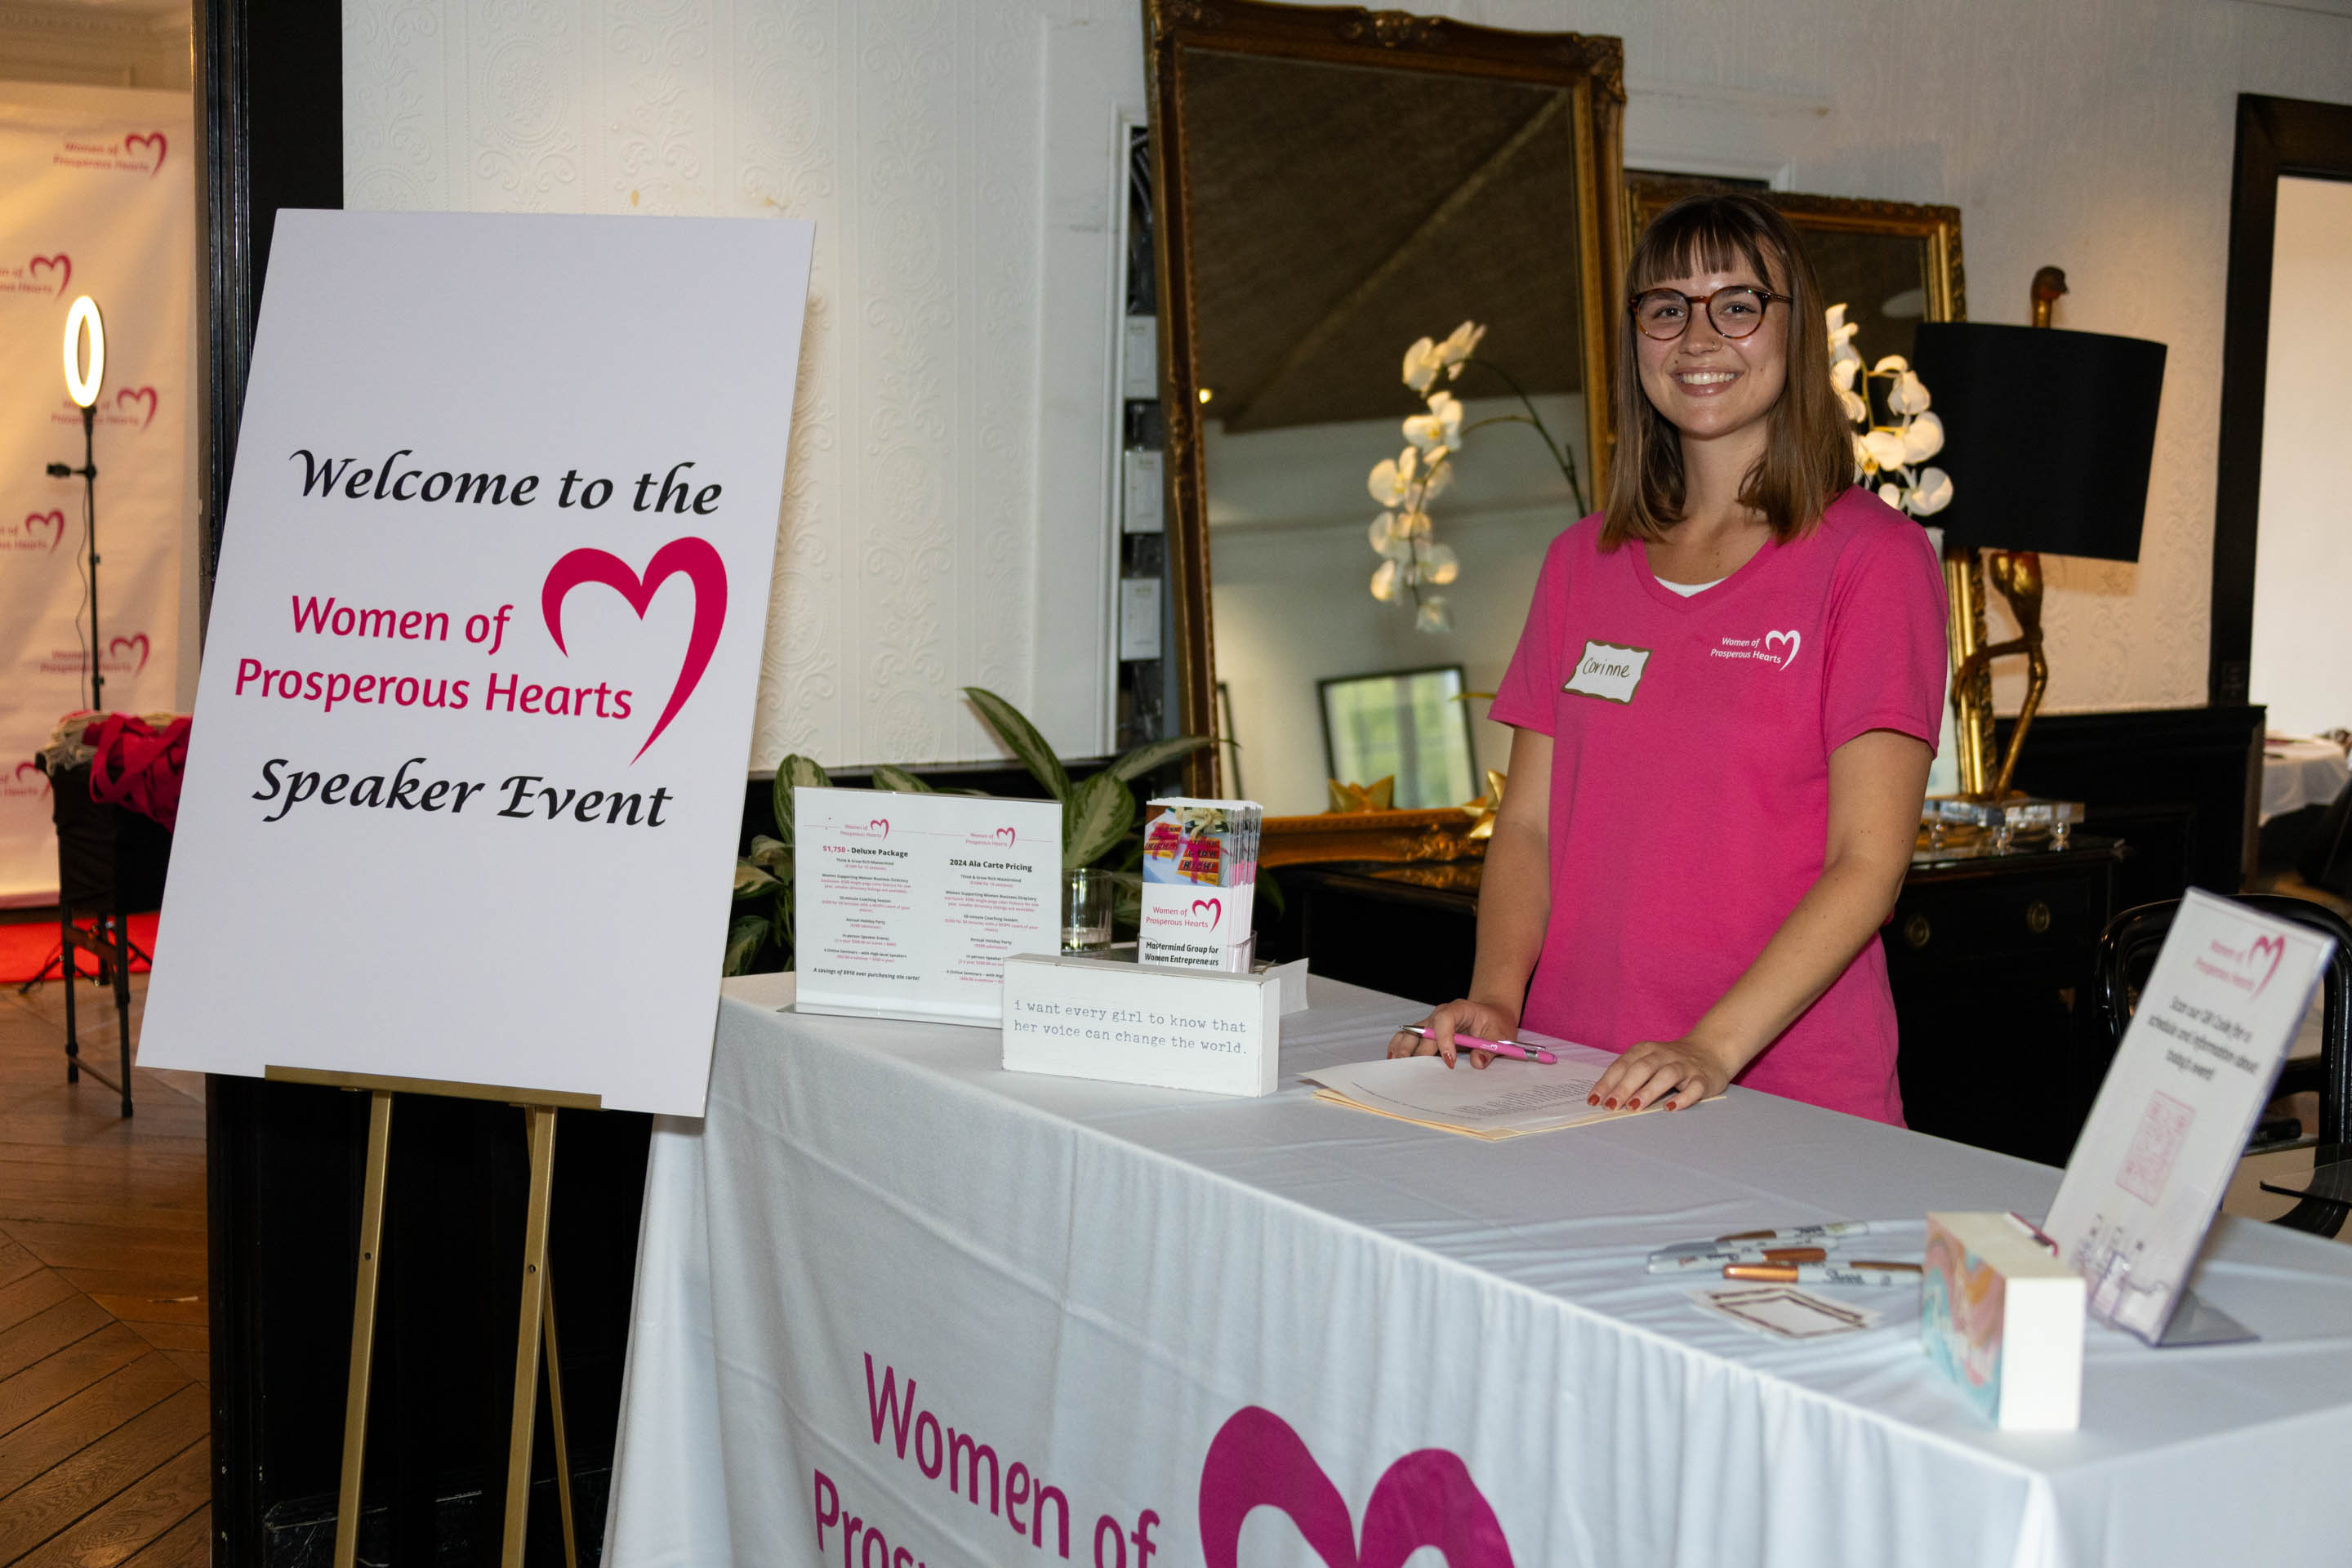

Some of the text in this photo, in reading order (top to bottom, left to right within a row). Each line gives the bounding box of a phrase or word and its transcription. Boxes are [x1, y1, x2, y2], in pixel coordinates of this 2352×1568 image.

[289, 449, 723, 515] Welcome to the
[292, 595, 514, 656] Women of
[1722, 636, 1761, 649] Women of
[1710, 648, 1782, 664] Prosperous Hearts
[1582, 657, 1631, 678] Corinne
[235, 658, 633, 719] Prosperous Hearts
[252, 757, 674, 826] Speaker Event
[823, 845, 846, 853] $1,750
[851, 847, 876, 855] Deluxe
[878, 849, 908, 858] Package
[982, 861, 1004, 869] Carte
[1005, 863, 1032, 872] Pricing
[1152, 906, 1188, 917] Women of
[1146, 917, 1209, 929] Prosperous Hearts
[1146, 942, 1219, 955] Mastermind Group for
[1144, 952, 1219, 967] Women Entrepreneurs
[1014, 1000, 1246, 1033] i want every girl to know that
[1014, 1020, 1247, 1054] her voice can change the world.
[863, 1352, 1160, 1568] Women of
